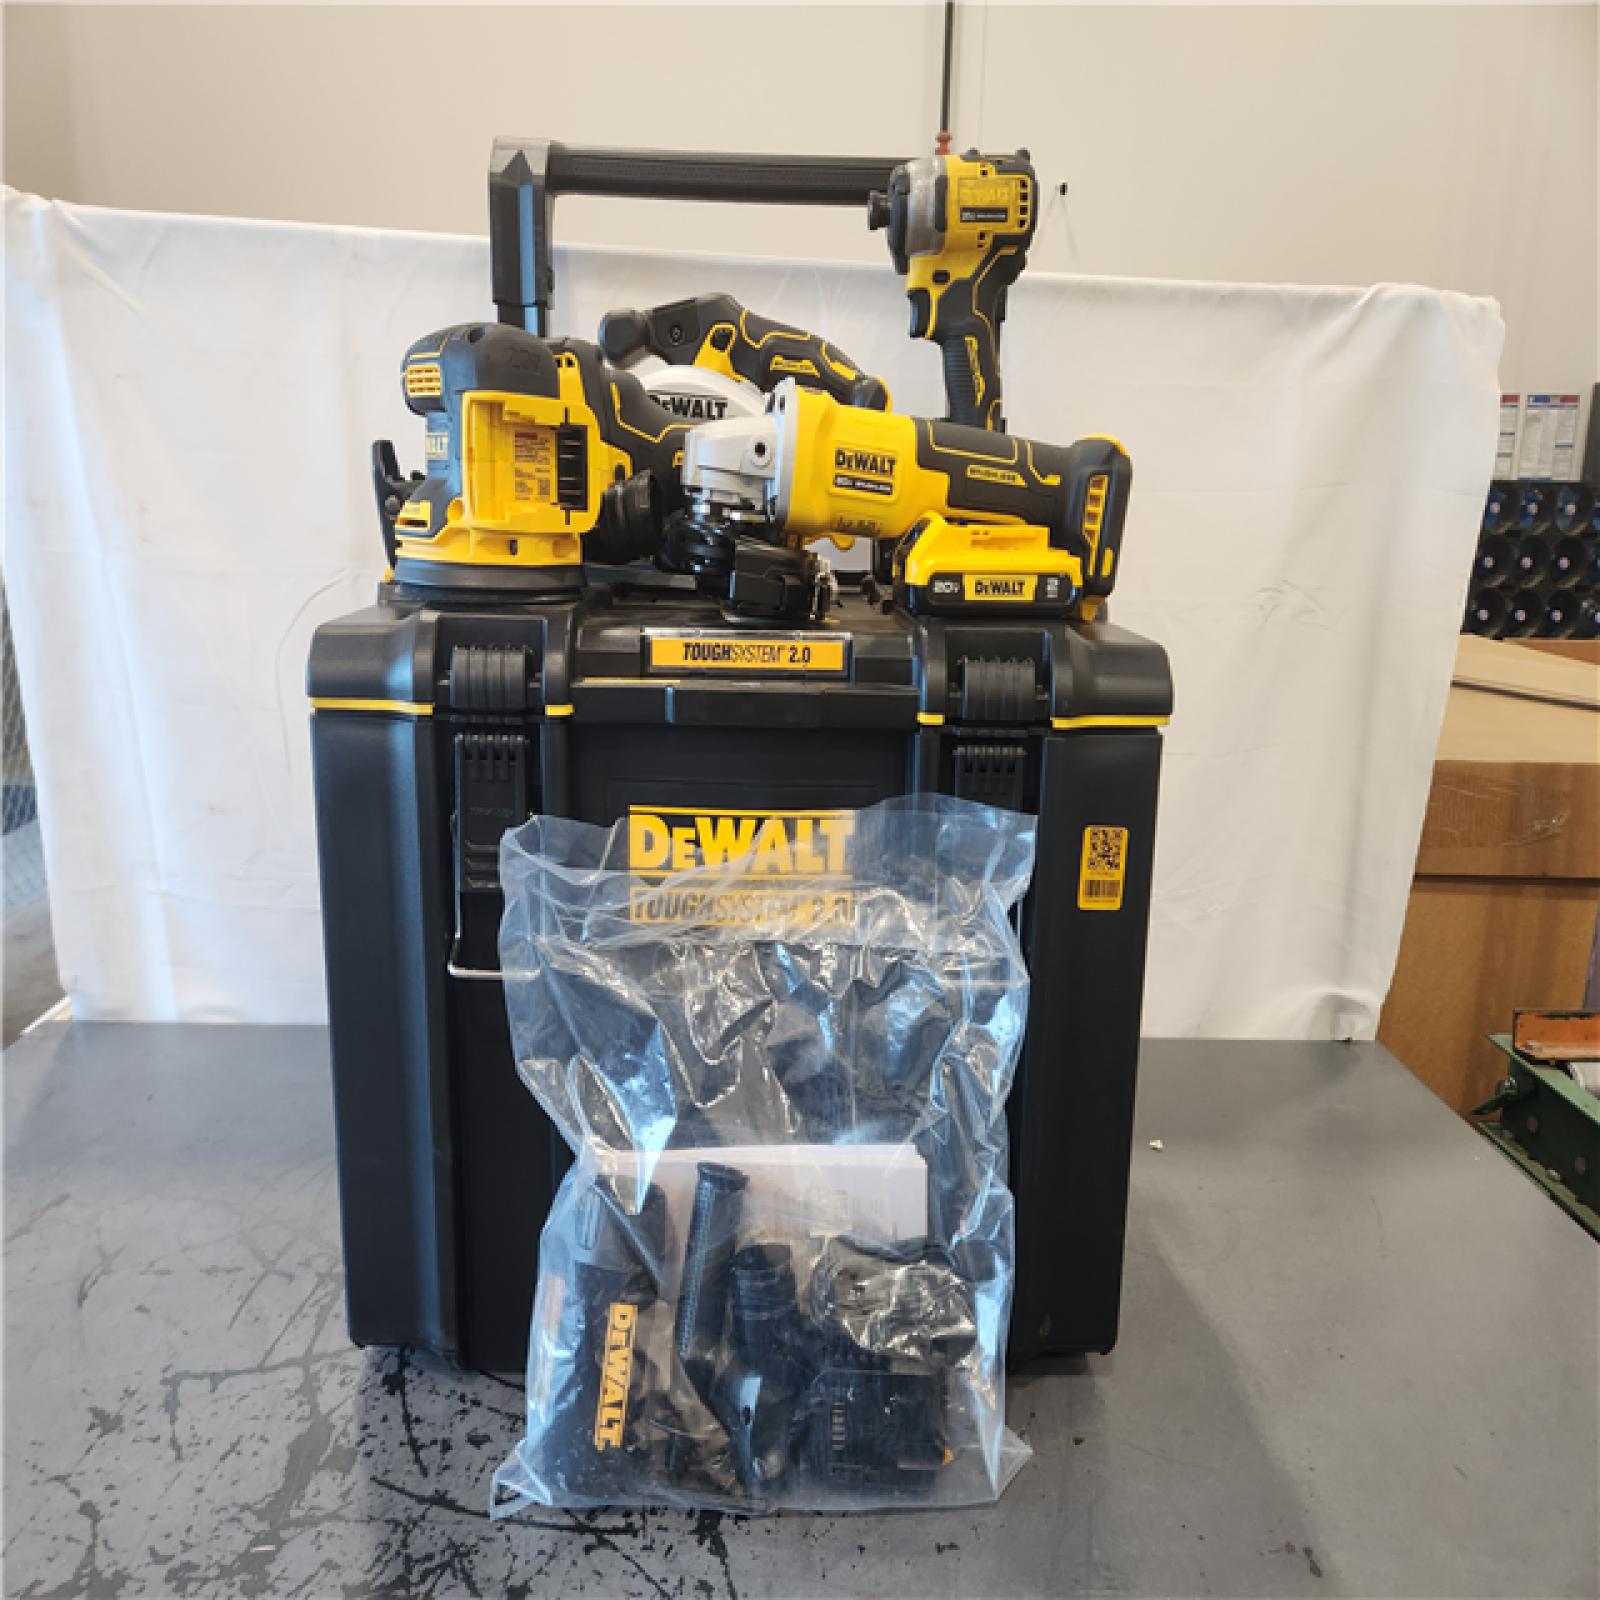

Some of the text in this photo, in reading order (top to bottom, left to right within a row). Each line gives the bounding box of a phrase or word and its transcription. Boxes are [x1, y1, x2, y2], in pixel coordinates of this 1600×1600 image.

[835, 449, 896, 476] DEWALT
[974, 580, 1025, 596] DEWALT
[789, 644, 811, 664] 2.0
[629, 813, 856, 874] DEWALT
[599, 1304, 635, 1450] DEWALT
